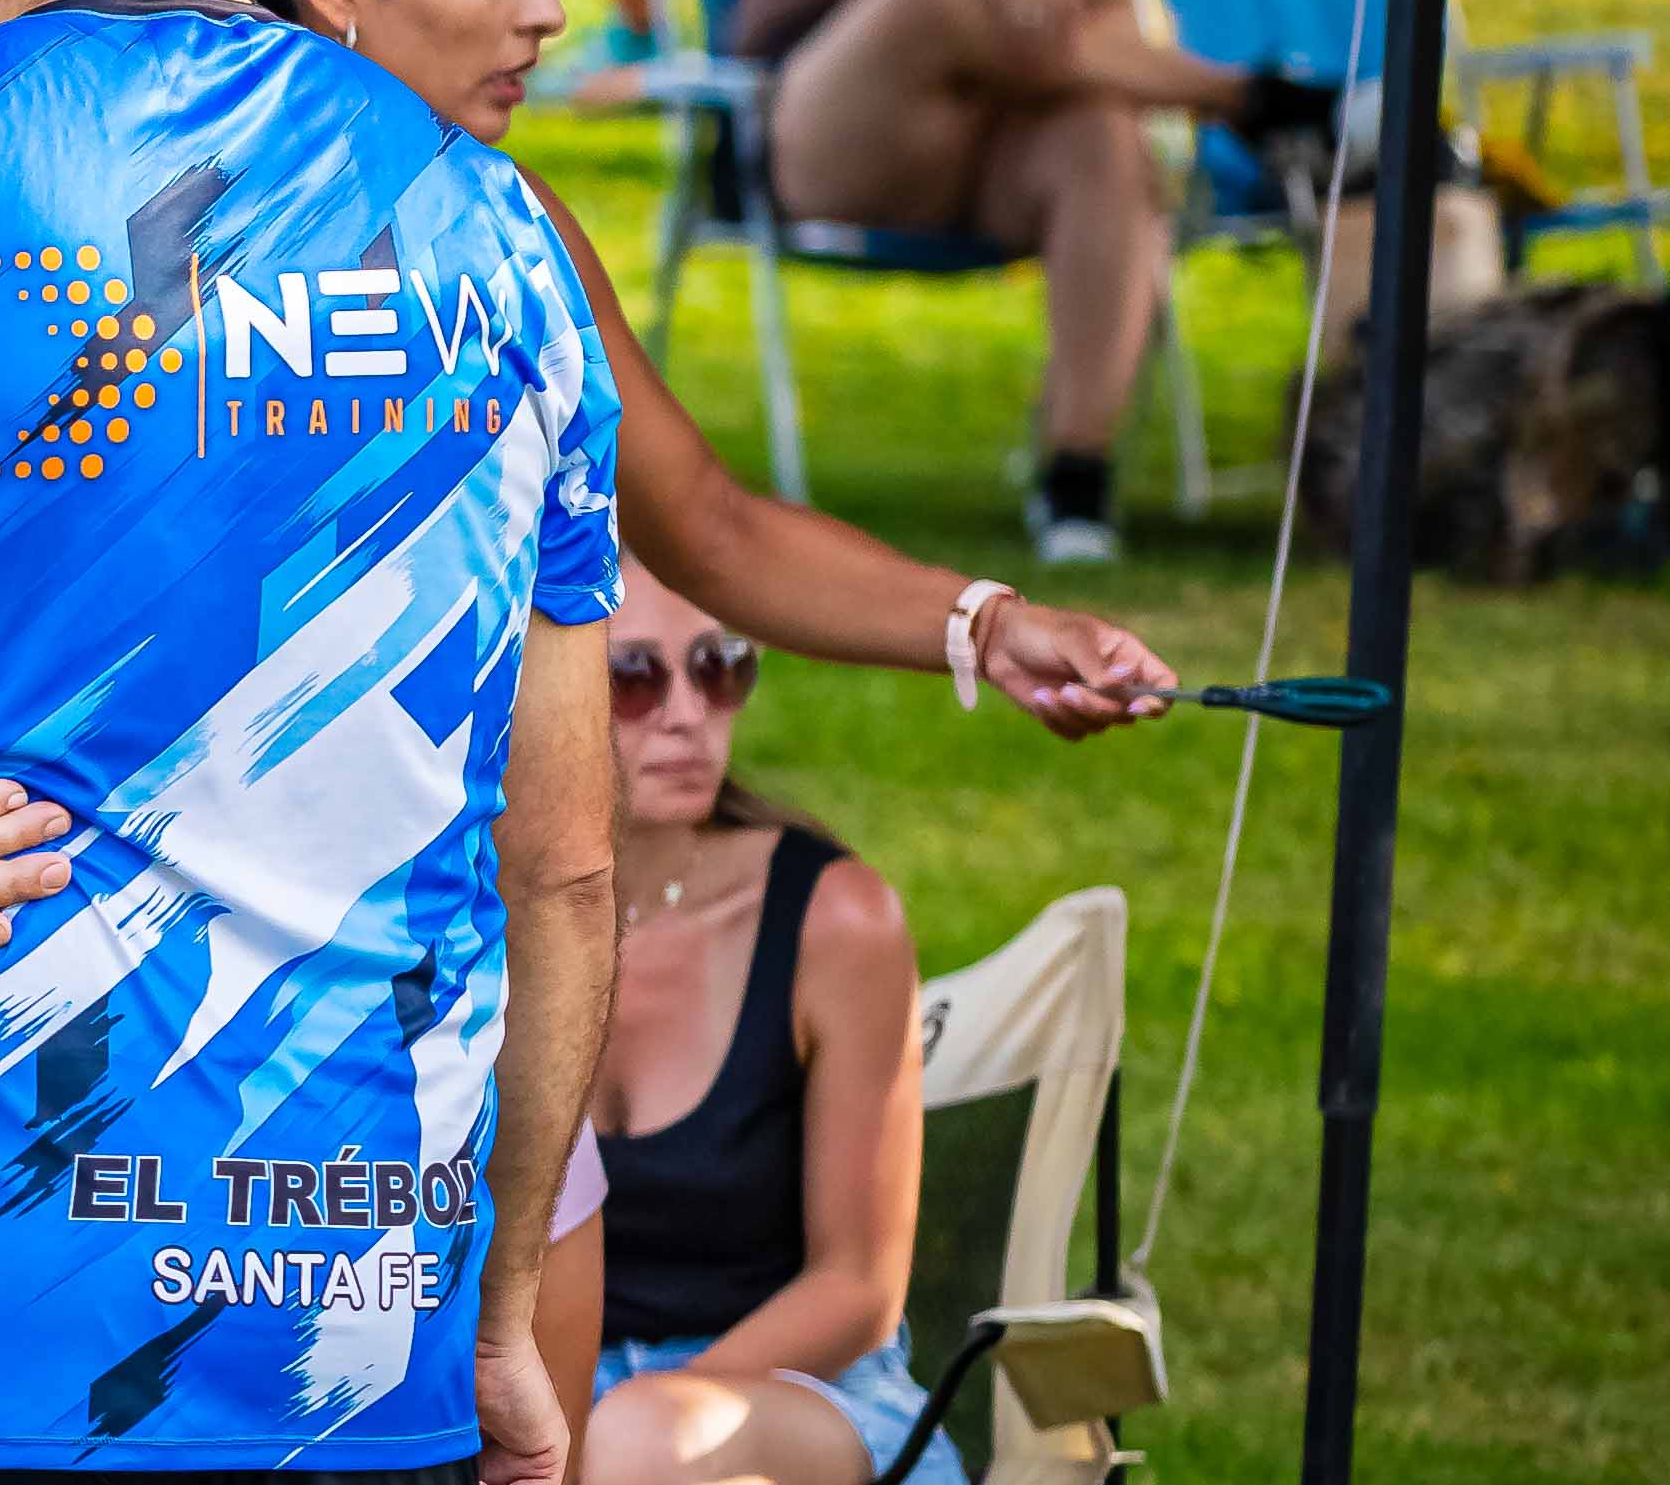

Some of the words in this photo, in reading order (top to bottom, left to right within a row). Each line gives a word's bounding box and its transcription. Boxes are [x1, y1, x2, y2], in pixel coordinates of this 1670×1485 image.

[215, 268, 514, 378] NEW
[226, 397, 502, 437] TRAINING
[68, 1154, 188, 1224] EL
[151, 1246, 364, 1312] SANTA
[378, 1252, 441, 1312] FE
